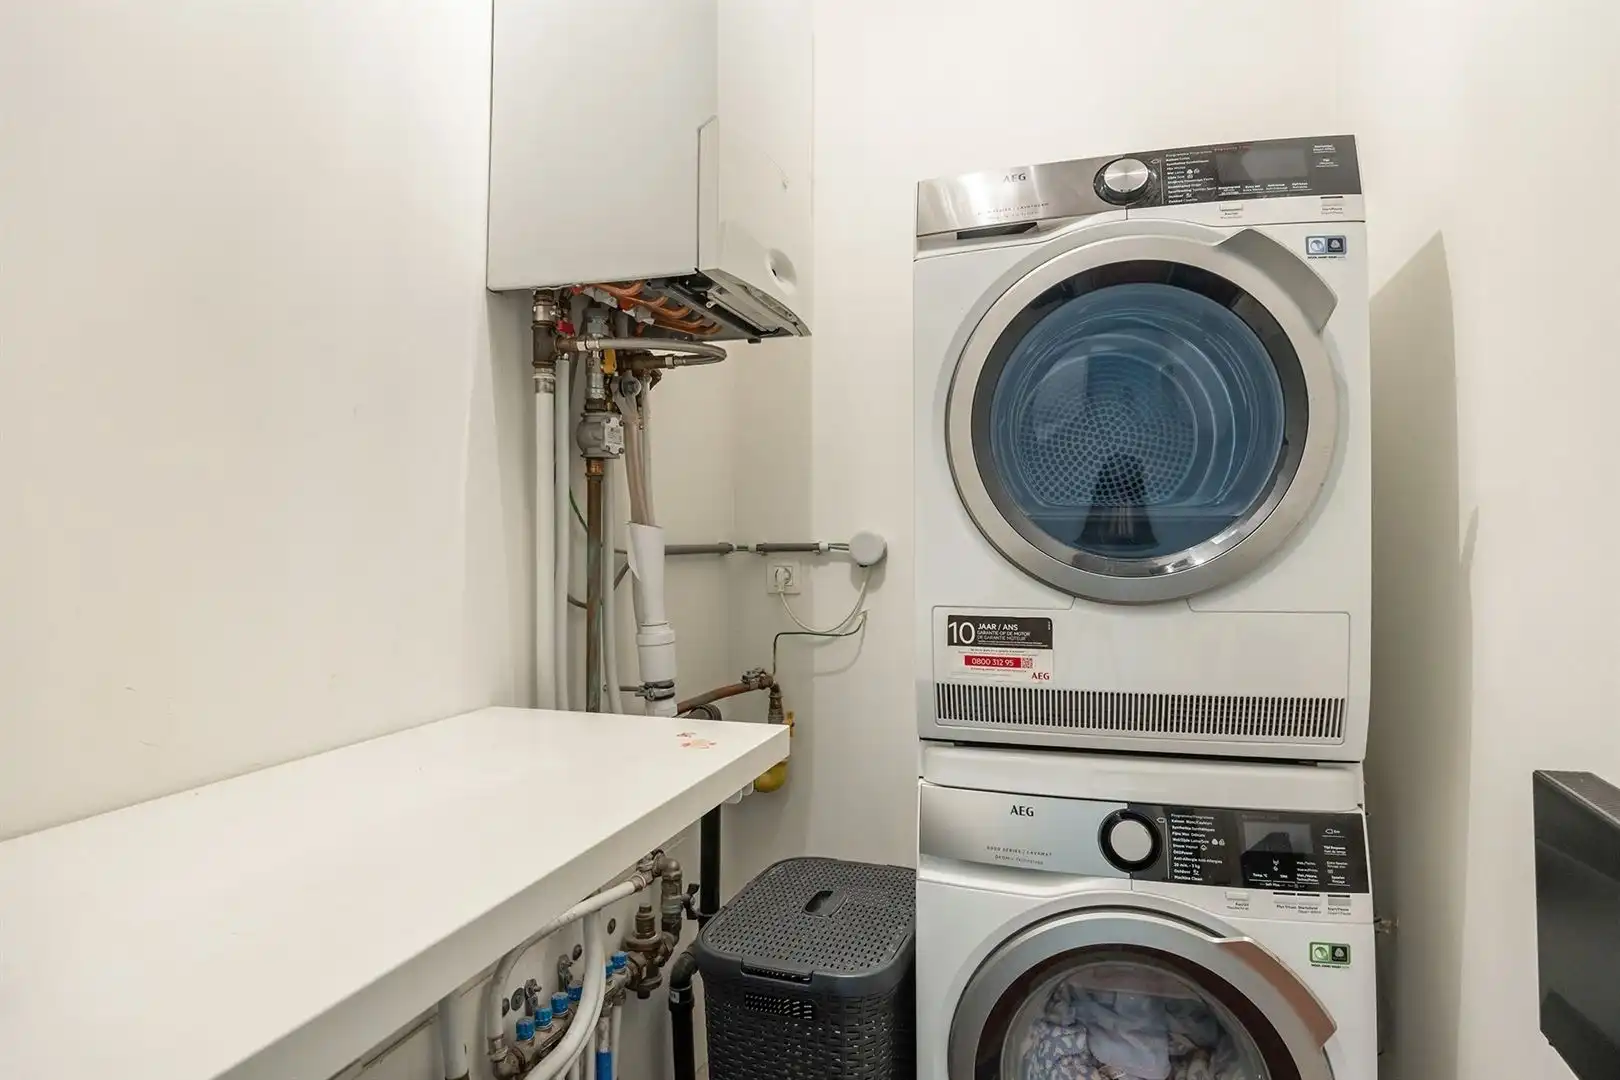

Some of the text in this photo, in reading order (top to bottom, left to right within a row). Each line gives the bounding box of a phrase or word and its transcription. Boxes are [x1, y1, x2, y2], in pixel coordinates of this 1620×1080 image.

[1003, 173, 1026, 183] AEG
[948, 621, 976, 644] 10
[971, 658, 1014, 667] 0800 312 95
[1031, 672, 1050, 680] AEG
[1010, 804, 1034, 817] AEG
